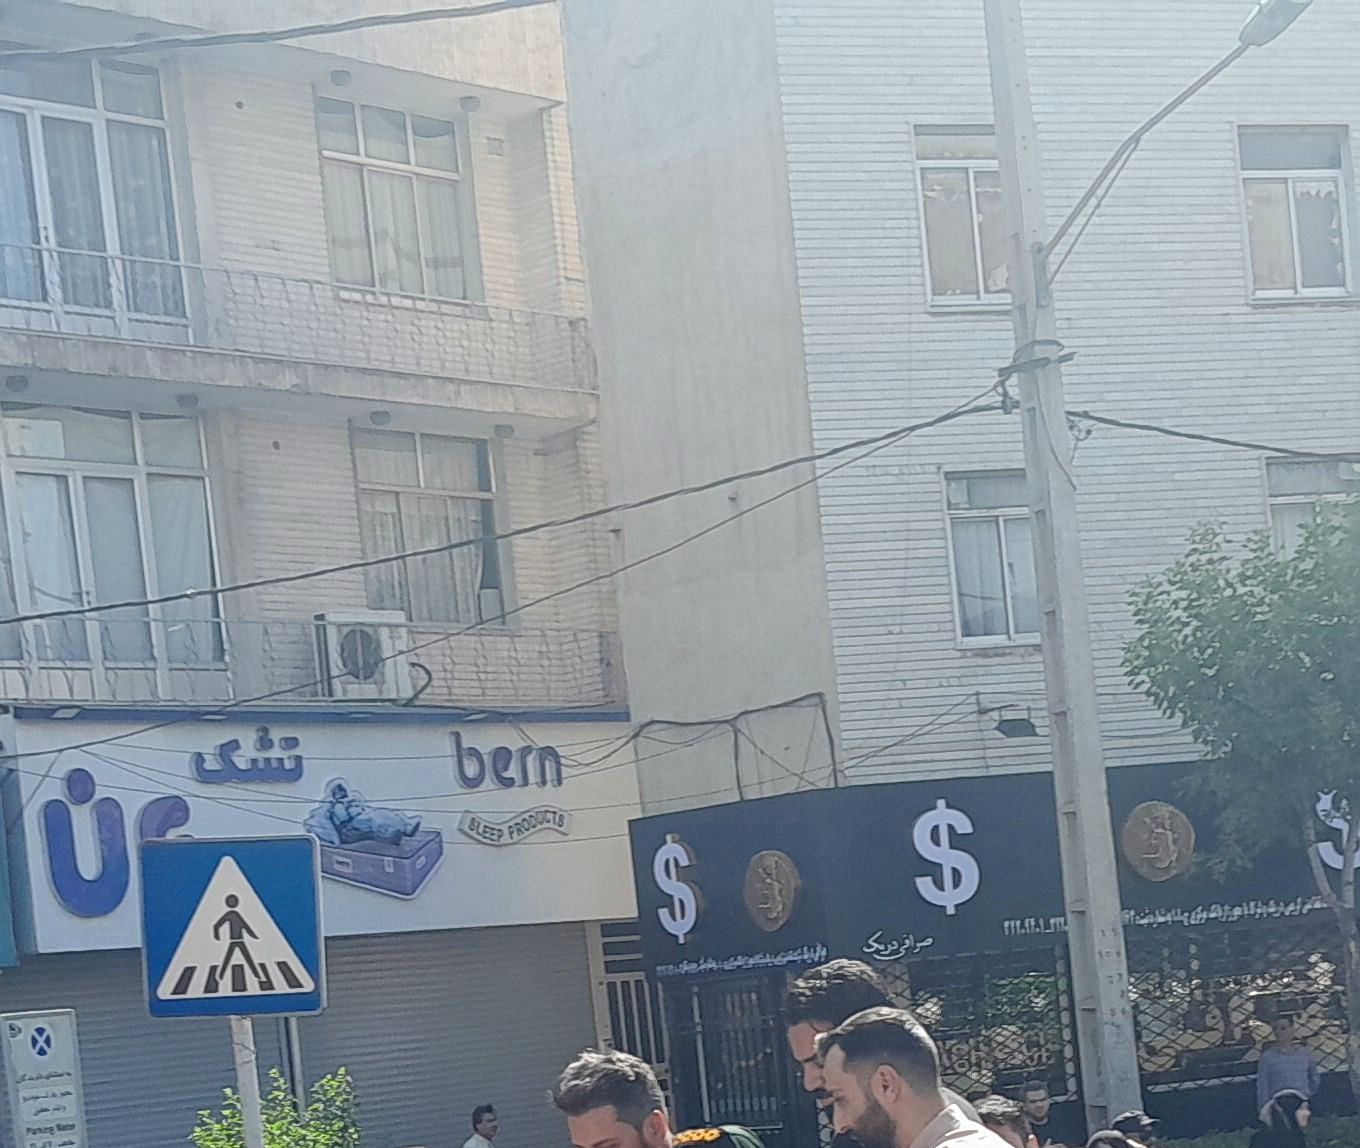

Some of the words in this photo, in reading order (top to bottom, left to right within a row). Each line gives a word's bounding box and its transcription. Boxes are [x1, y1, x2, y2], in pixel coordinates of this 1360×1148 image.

[189, 725, 304, 785] تشک
[449, 728, 564, 791] bern
[467, 816, 505, 842] SLEEP
[507, 808, 566, 841] PRODUCTS
